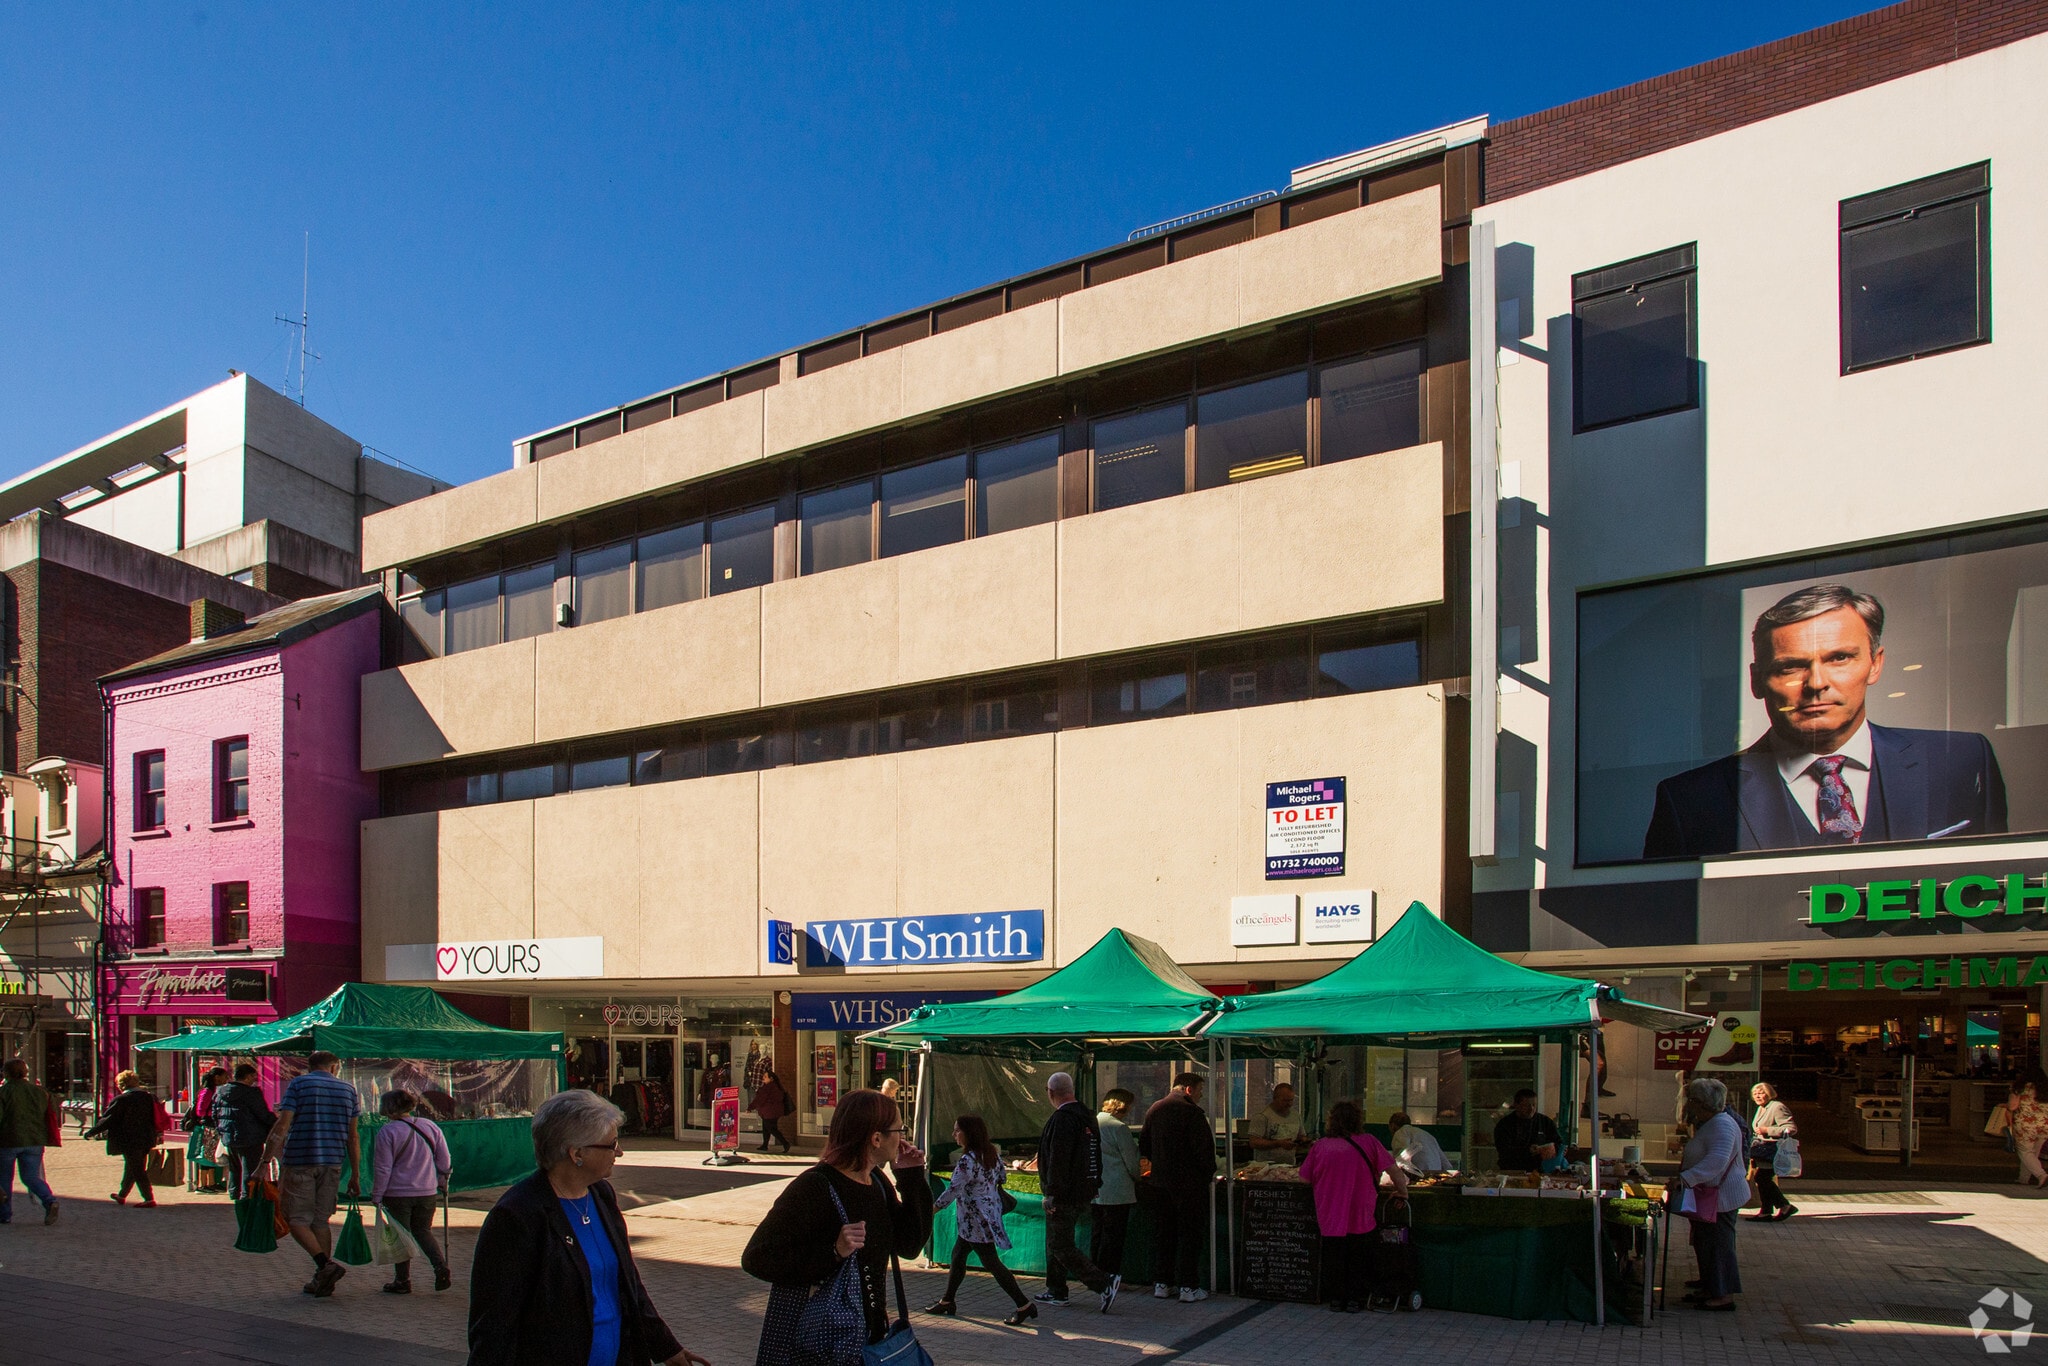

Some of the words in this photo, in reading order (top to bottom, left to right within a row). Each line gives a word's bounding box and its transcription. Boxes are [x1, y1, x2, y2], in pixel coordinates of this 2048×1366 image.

[1276, 784, 1312, 796] Michael
[1289, 794, 1321, 805] Rogers
[1272, 809, 1299, 824] TO
[1305, 806, 1338, 821] LET
[1280, 829, 1318, 837] CONDITIONED
[1270, 858, 1300, 868] 01732
[1302, 856, 1339, 866] 740000
[1269, 865, 1340, 876] www.michaelrogers.co.uk
[1808, 873, 2048, 924] DEICH
[1315, 904, 1361, 917] HAYS
[1235, 913, 1292, 926] officeangels
[1315, 917, 1340, 925] Recruiting
[777, 923, 790, 933] WH
[812, 914, 1032, 964] WHSmith
[777, 932, 791, 961] S
[461, 944, 541, 974] YOURS
[137, 964, 226, 1007] Paperchase
[622, 1004, 683, 1027] YOURS
[1657, 1038, 1701, 1051] OFF
[1277, 1200, 1305, 1209] HERE
[1291, 1222, 1306, 1230] 70
